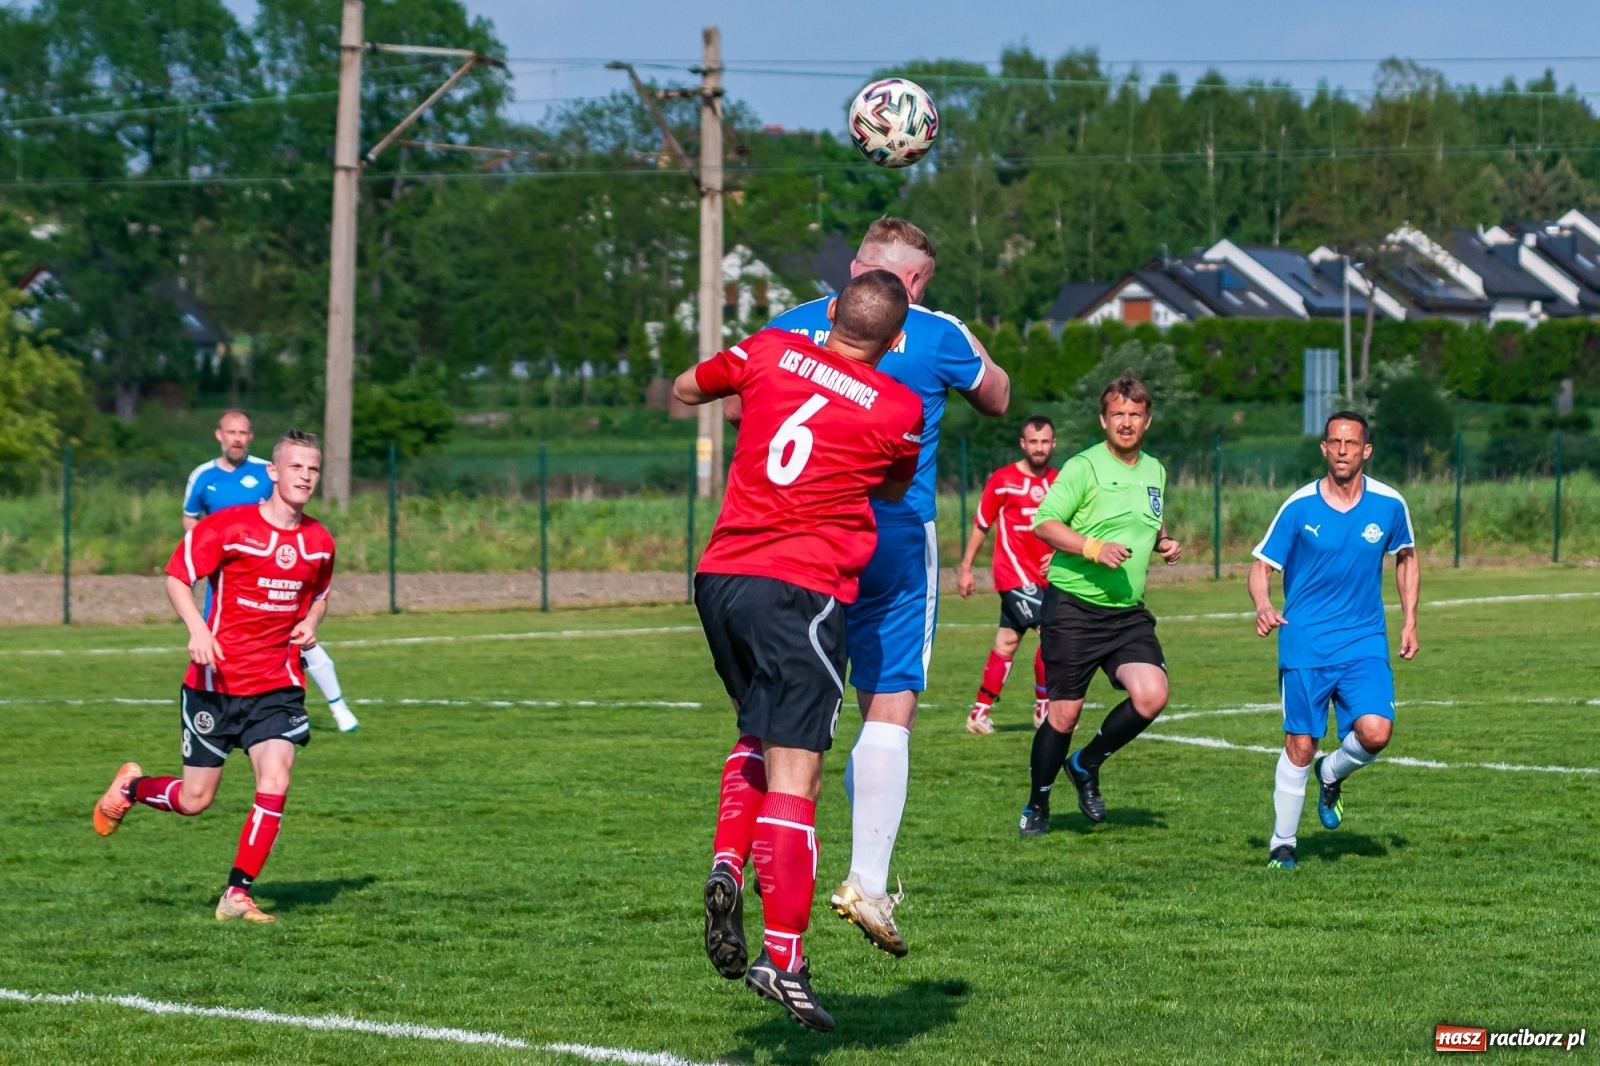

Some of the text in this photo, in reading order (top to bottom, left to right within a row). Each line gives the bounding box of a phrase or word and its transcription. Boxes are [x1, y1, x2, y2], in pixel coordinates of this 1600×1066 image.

[777, 348, 879, 411] LKS 07 MARKOWICE
[766, 392, 830, 486] 6
[257, 576, 303, 590] ELEKTRO
[268, 589, 298, 600] MART
[182, 728, 192, 758] 8
